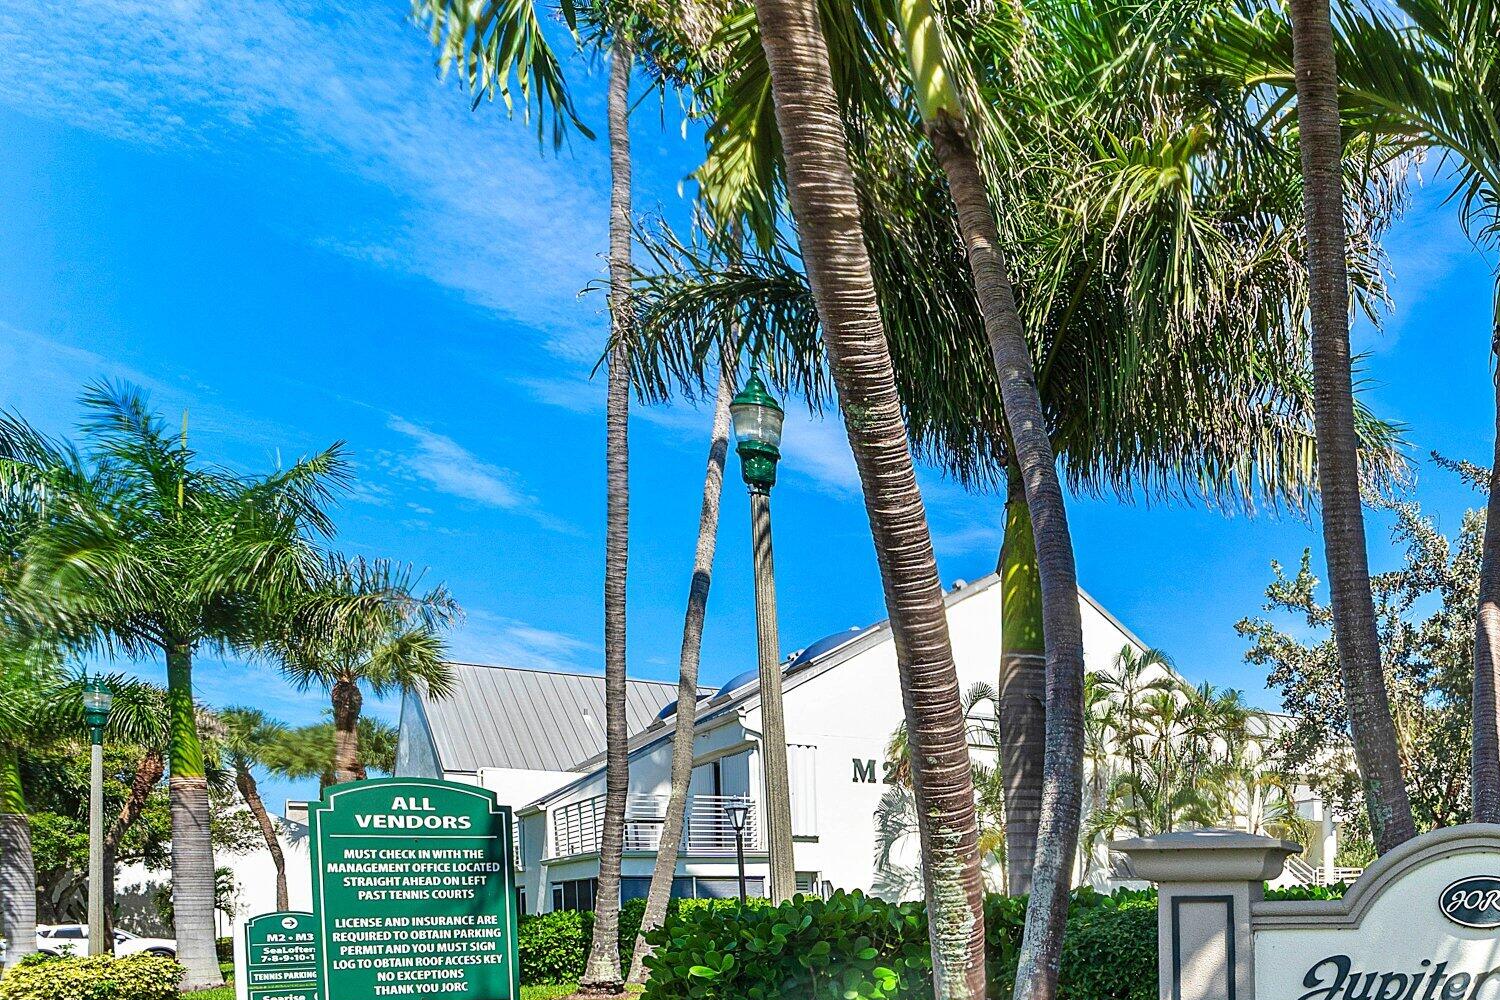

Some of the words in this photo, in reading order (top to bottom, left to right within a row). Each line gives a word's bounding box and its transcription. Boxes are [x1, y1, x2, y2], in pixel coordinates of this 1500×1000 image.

[391, 796, 436, 811] ALL
[354, 814, 472, 829] VENDORS
[344, 849, 377, 860] MUST
[379, 849, 416, 860] CHECK
[418, 849, 431, 859] IN
[431, 849, 462, 859] WITH
[463, 849, 484, 859] THE
[327, 863, 411, 873] MANAGEMENT
[412, 863, 451, 873] OFFICE
[452, 862, 500, 872] LOCATED
[343, 877, 401, 887] STRAIGHT
[402, 876, 441, 886] AHEAD
[442, 876, 460, 886] ON
[461, 876, 487, 886] LEFT
[358, 890, 387, 900] PAST
[388, 890, 429, 900] TENNIS
[431, 889, 475, 899] COURTS
[335, 917, 382, 928] LICENSE
[384, 917, 410, 927] AND
[411, 915, 475, 926] INSURANCE
[476, 915, 498, 925] ARE
[266, 933, 286, 941] M2
[332, 931, 391, 942] REQUIRED
[392, 931, 409, 940] TO
[410, 929, 452, 940] OBTAIN
[453, 928, 502, 939] PARKING
[340, 945, 384, 956] PERMIT
[385, 944, 411, 954] AND
[411, 943, 435, 954] YOU
[436, 942, 468, 953] MUST
[469, 941, 496, 952] SIGN
[333, 959, 356, 970] LOG
[357, 958, 372, 969] TO
[373, 957, 414, 968] OBTAIN
[415, 956, 444, 967] ROOF
[445, 955, 482, 966] ACCESS
[483, 954, 503, 964] KEY
[284, 971, 317, 979] PARKING
[377, 971, 395, 982] NO
[396, 969, 464, 981] EXCEPTIONS
[374, 984, 414, 996] THANK
[415, 983, 439, 994] YOU
[440, 981, 468, 993] JORC
